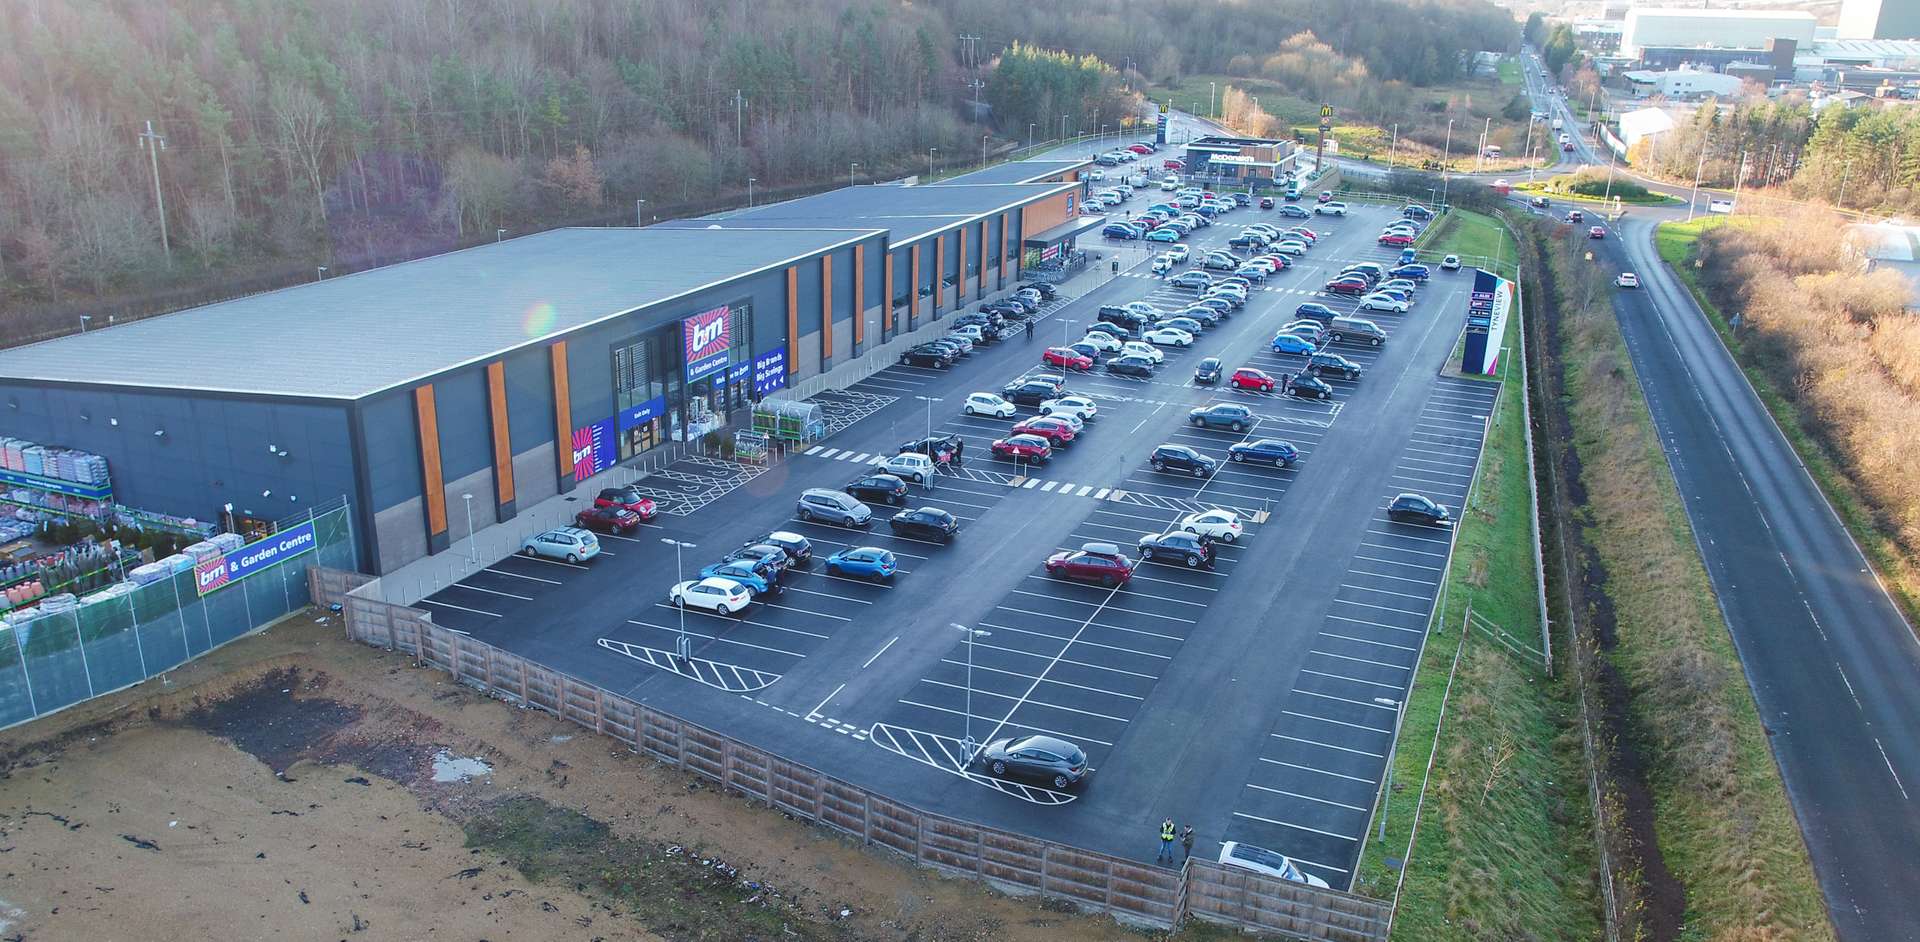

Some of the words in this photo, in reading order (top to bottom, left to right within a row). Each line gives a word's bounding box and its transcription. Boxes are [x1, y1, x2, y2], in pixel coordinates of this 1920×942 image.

[1210, 153, 1254, 162] McDonald's
[1492, 290, 1504, 330] TYNEVIEW
[695, 361, 712, 374] Garden
[712, 356, 728, 367] Centre
[757, 360, 765, 370] Big
[757, 372, 765, 382] Big
[230, 562, 239, 572] &
[241, 547, 278, 567] Garden
[280, 533, 312, 552] Centre
